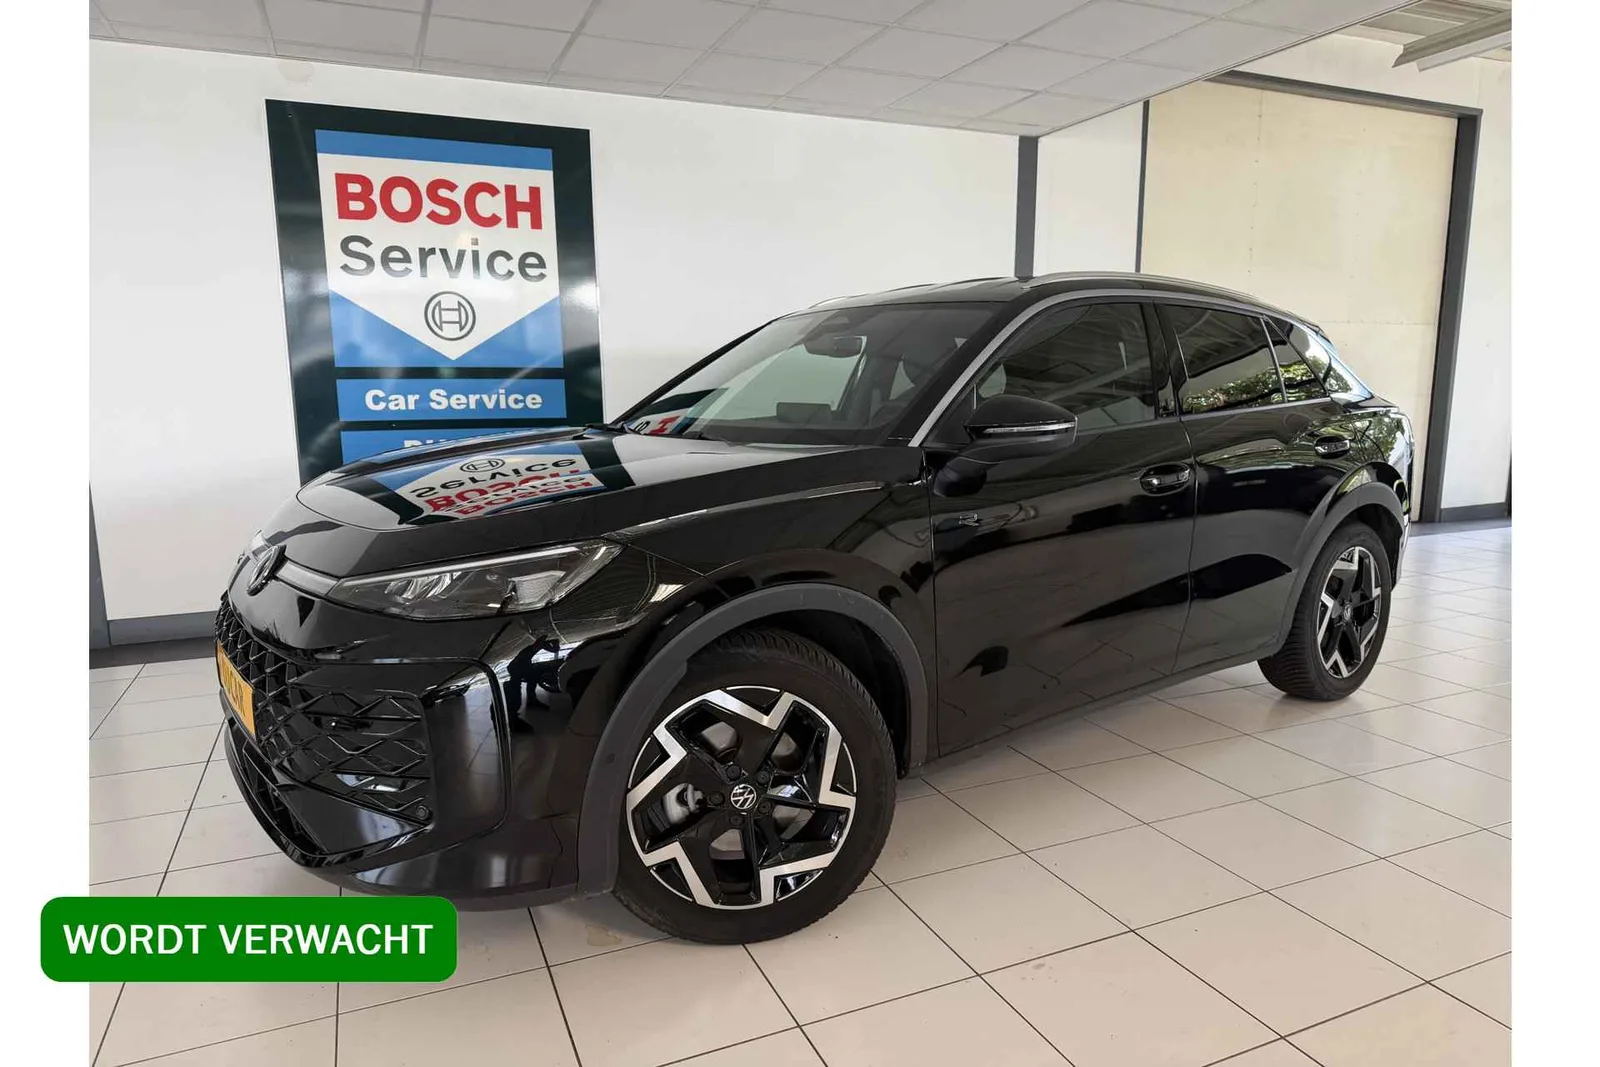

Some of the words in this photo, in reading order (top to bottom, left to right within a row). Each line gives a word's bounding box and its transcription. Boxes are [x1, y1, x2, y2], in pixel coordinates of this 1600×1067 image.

[334, 172, 543, 230] BOSCH
[339, 235, 547, 282] Service
[364, 389, 420, 411] Car
[429, 388, 543, 410] Service
